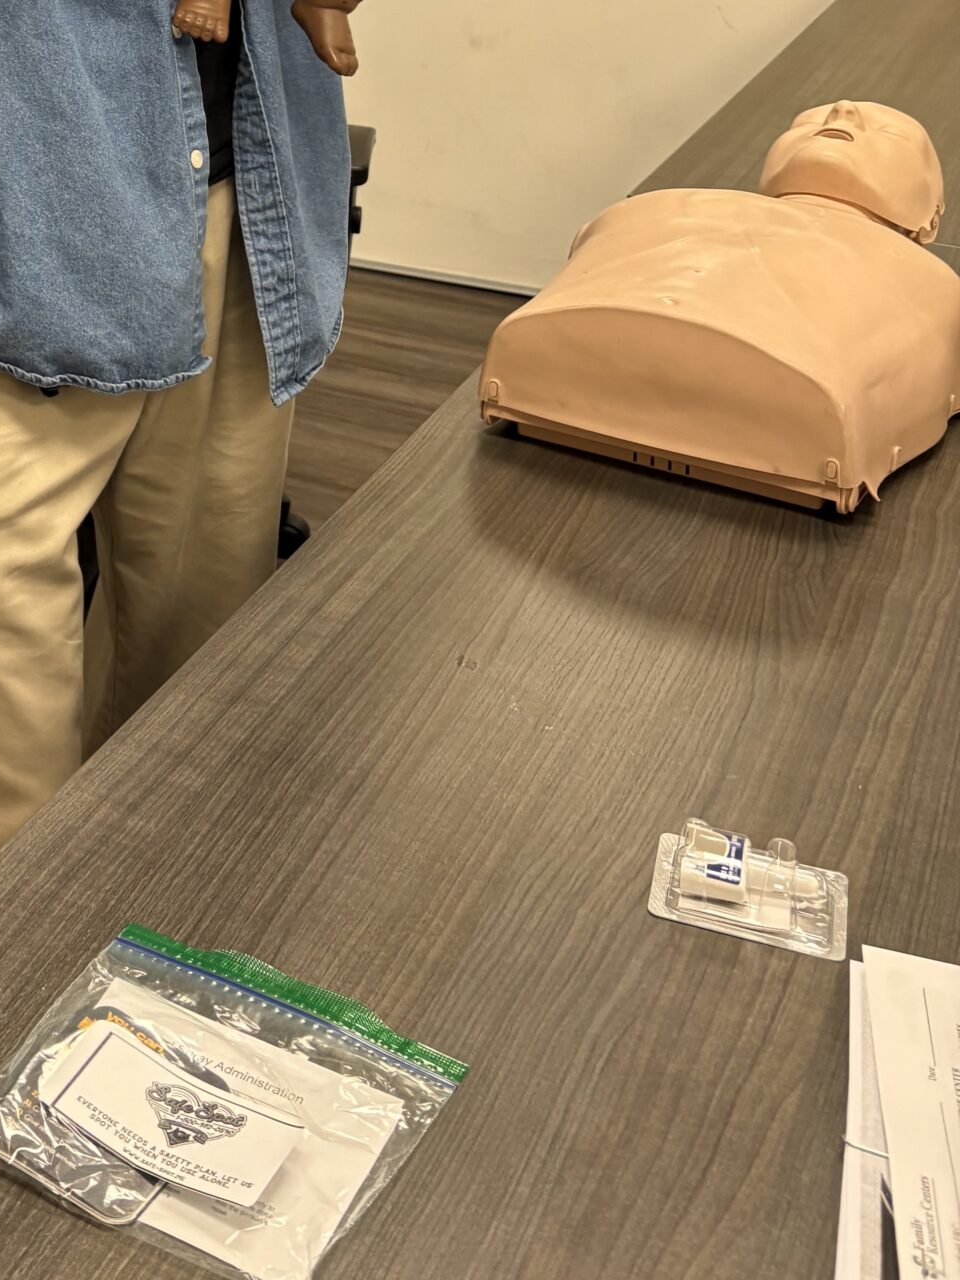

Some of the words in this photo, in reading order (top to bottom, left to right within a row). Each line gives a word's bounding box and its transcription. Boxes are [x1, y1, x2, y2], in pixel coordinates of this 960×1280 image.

[145, 1081, 194, 1114] Safe
[195, 1102, 246, 1127] Spot
[216, 1059, 304, 1104] Administration
[77, 1095, 119, 1127] EVERYONE
[121, 1126, 149, 1144] NEEDS
[159, 1149, 192, 1167] SAFETY
[222, 1174, 239, 1184] LET
[241, 1181, 254, 1189] US
[89, 1113, 113, 1131] SPOT
[113, 1130, 131, 1144] YOU
[133, 1142, 159, 1160] WHEN
[161, 1157, 178, 1169] YOU
[181, 1166, 199, 1178] USE
[920, 1174, 933, 1211] Centers
[910, 1217, 925, 1249] Family
[925, 1210, 939, 1254] Resource
